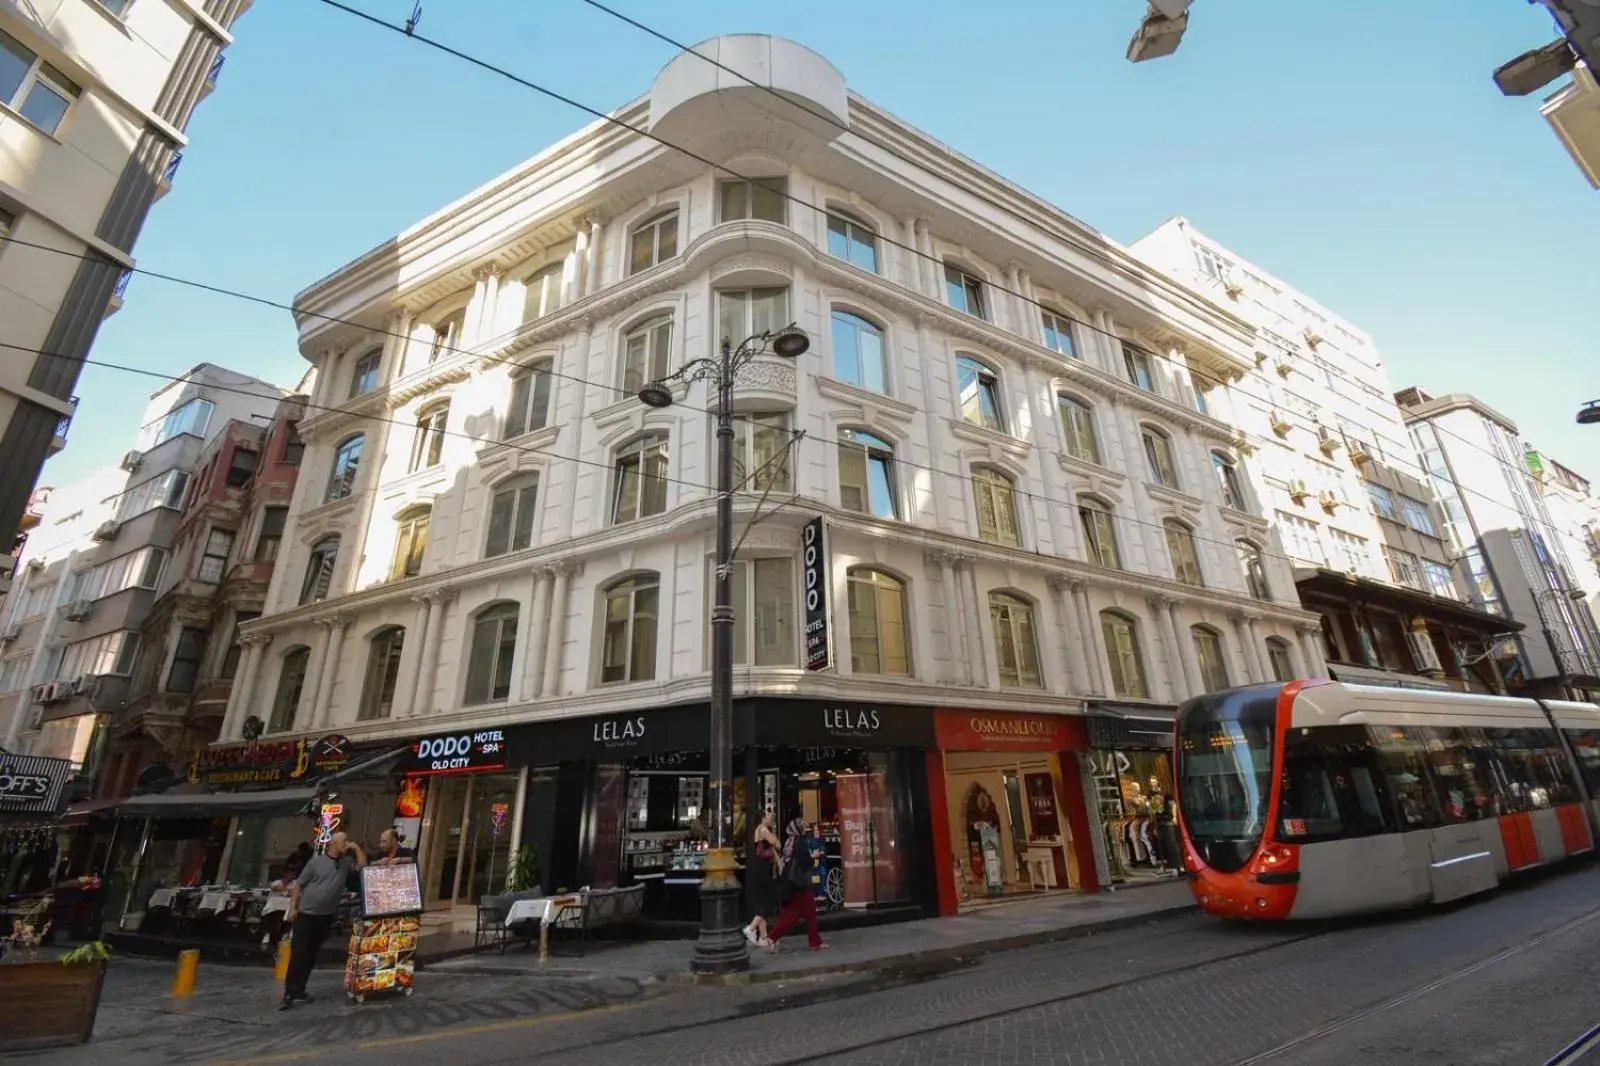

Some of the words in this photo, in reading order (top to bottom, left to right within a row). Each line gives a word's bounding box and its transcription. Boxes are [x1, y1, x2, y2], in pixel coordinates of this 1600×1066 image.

[805, 525, 818, 611] DODO
[593, 717, 646, 742] LELAS
[823, 708, 880, 730] LELAS
[418, 735, 471, 759] DODO
[474, 730, 505, 743] HOTEL
[482, 743, 499, 754] SPA
[431, 760, 449, 770] OLD
[450, 758, 470, 768] CITY
